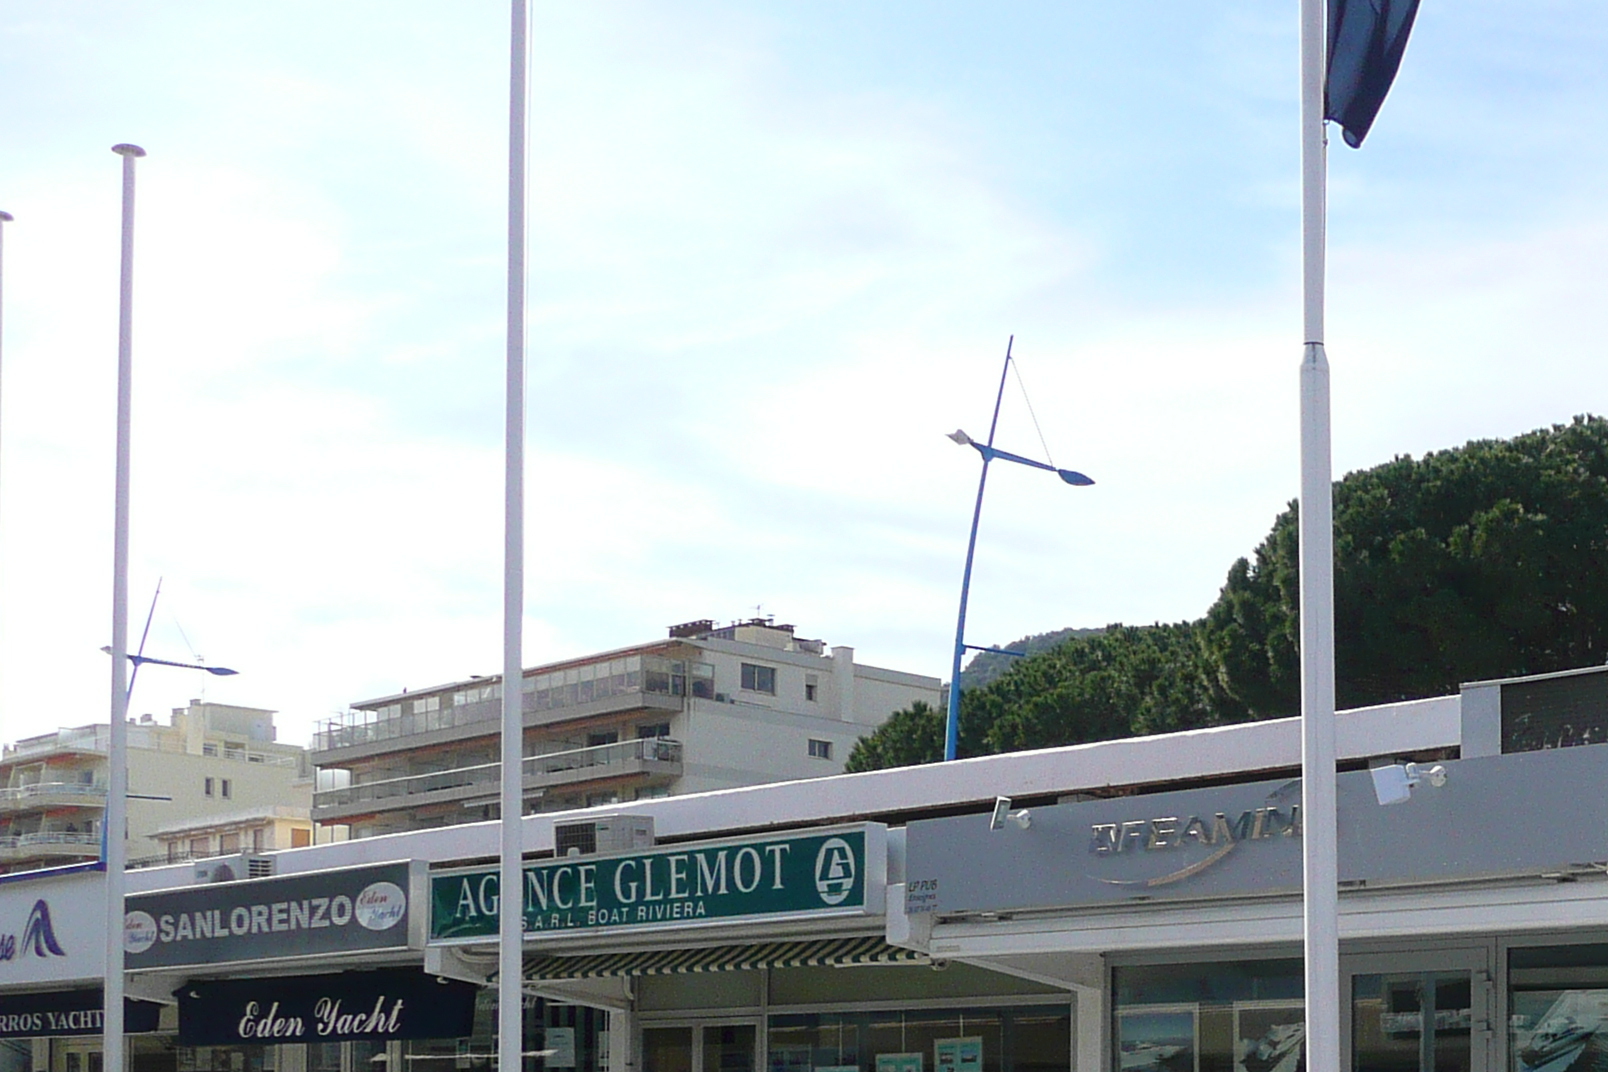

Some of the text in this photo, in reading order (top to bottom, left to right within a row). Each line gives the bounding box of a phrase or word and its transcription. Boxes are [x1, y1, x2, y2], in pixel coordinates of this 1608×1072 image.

[1088, 804, 1303, 852] DREAMIN
[455, 843, 791, 918] AGNCE GLEMOT
[159, 894, 353, 943] SANLORENZO
[588, 906, 631, 925] BOAT
[637, 900, 706, 922] RIVIERA
[237, 995, 404, 1038] Eden Yacht
